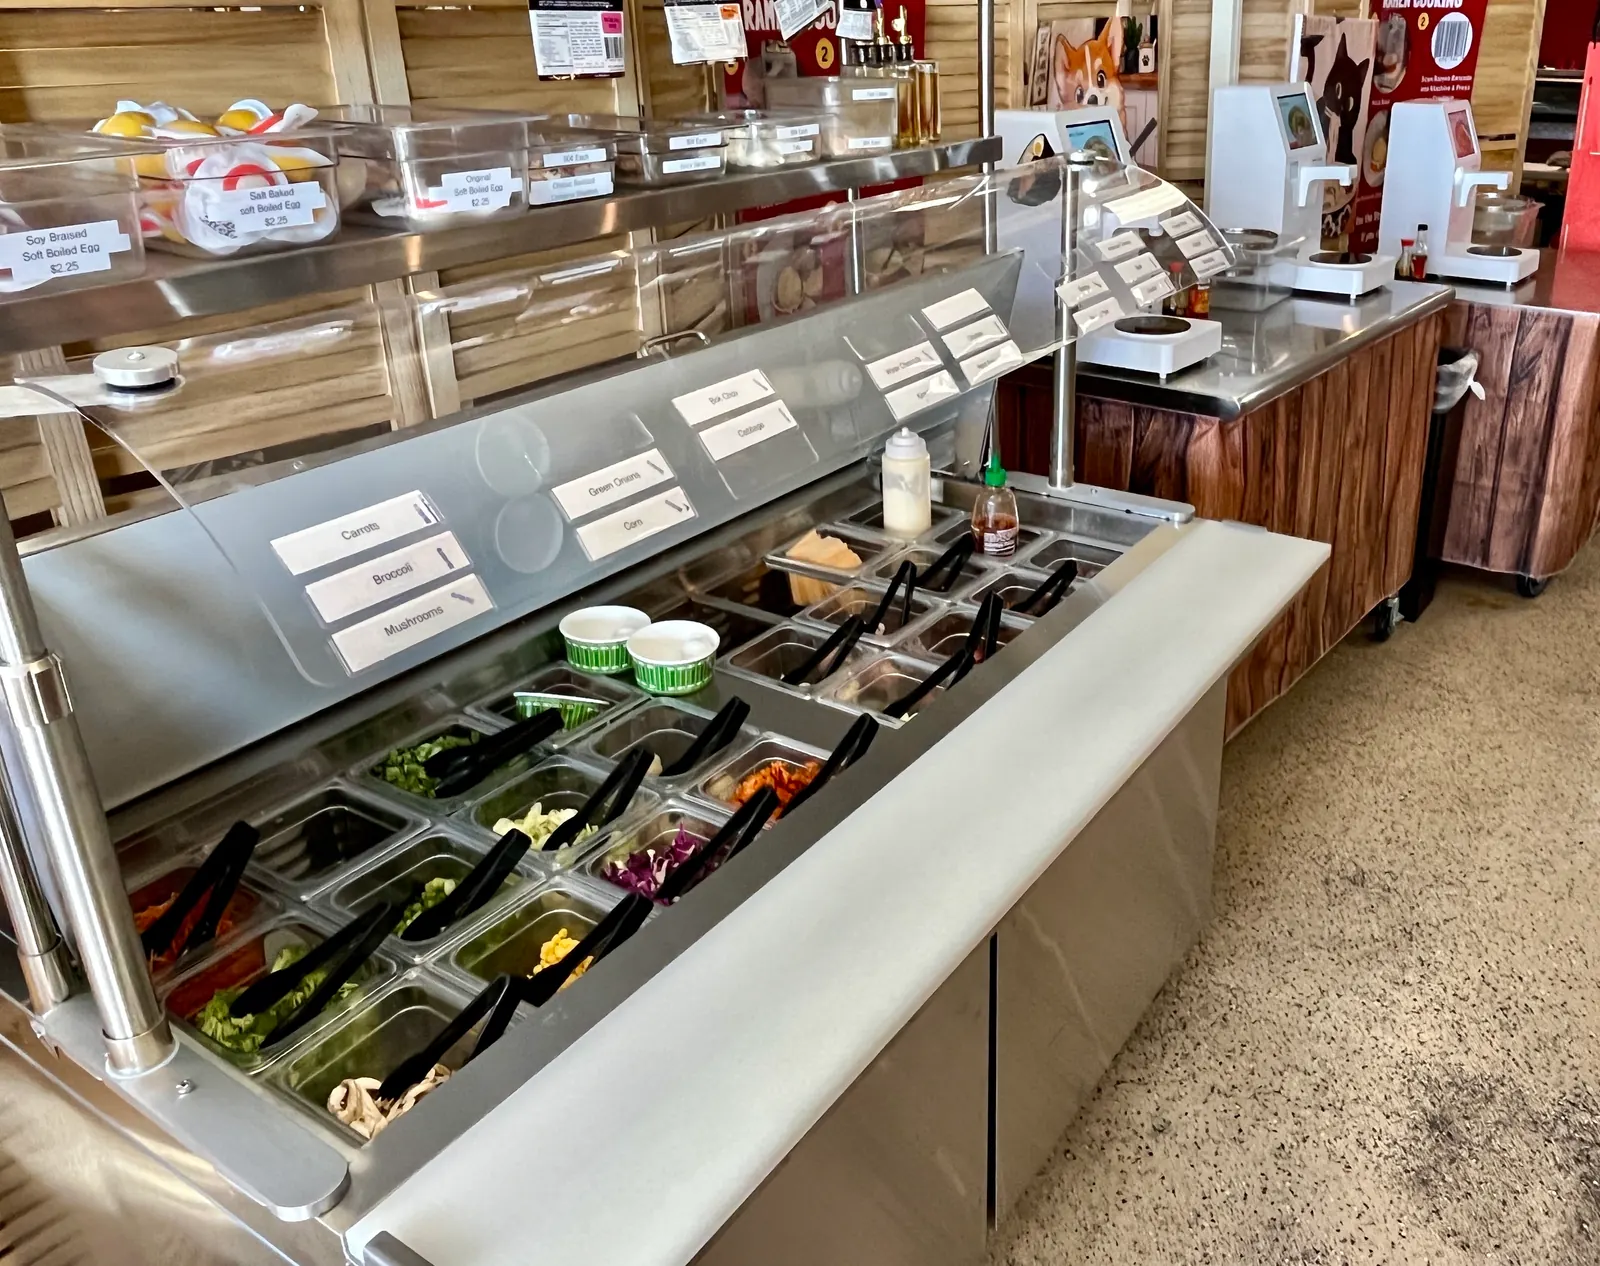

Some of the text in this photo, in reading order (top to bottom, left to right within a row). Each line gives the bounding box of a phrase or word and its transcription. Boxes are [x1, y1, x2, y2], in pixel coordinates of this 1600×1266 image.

[1420, 17, 1426, 27] 2
[821, 46, 828, 62] 2
[465, 173, 492, 183] Original
[249, 188, 295, 201] Salt Baked
[454, 184, 504, 197] Soft Boiled Egg
[257, 202, 283, 213] Boiled
[284, 200, 301, 209] Egg
[471, 197, 490, 207] $2.25
[264, 216, 288, 227] $2.25
[26, 228, 88, 246] Soy Braised
[22, 243, 100, 262] Soft Boiled Egg
[49, 261, 79, 274] $2.25
[737, 422, 765, 438] Cabbage
[588, 472, 642, 497] Green Onions
[341, 521, 381, 540] Carrots
[623, 518, 644, 531] Corn
[372, 562, 414, 585] Broccoli
[384, 605, 444, 637] Mushrooms
